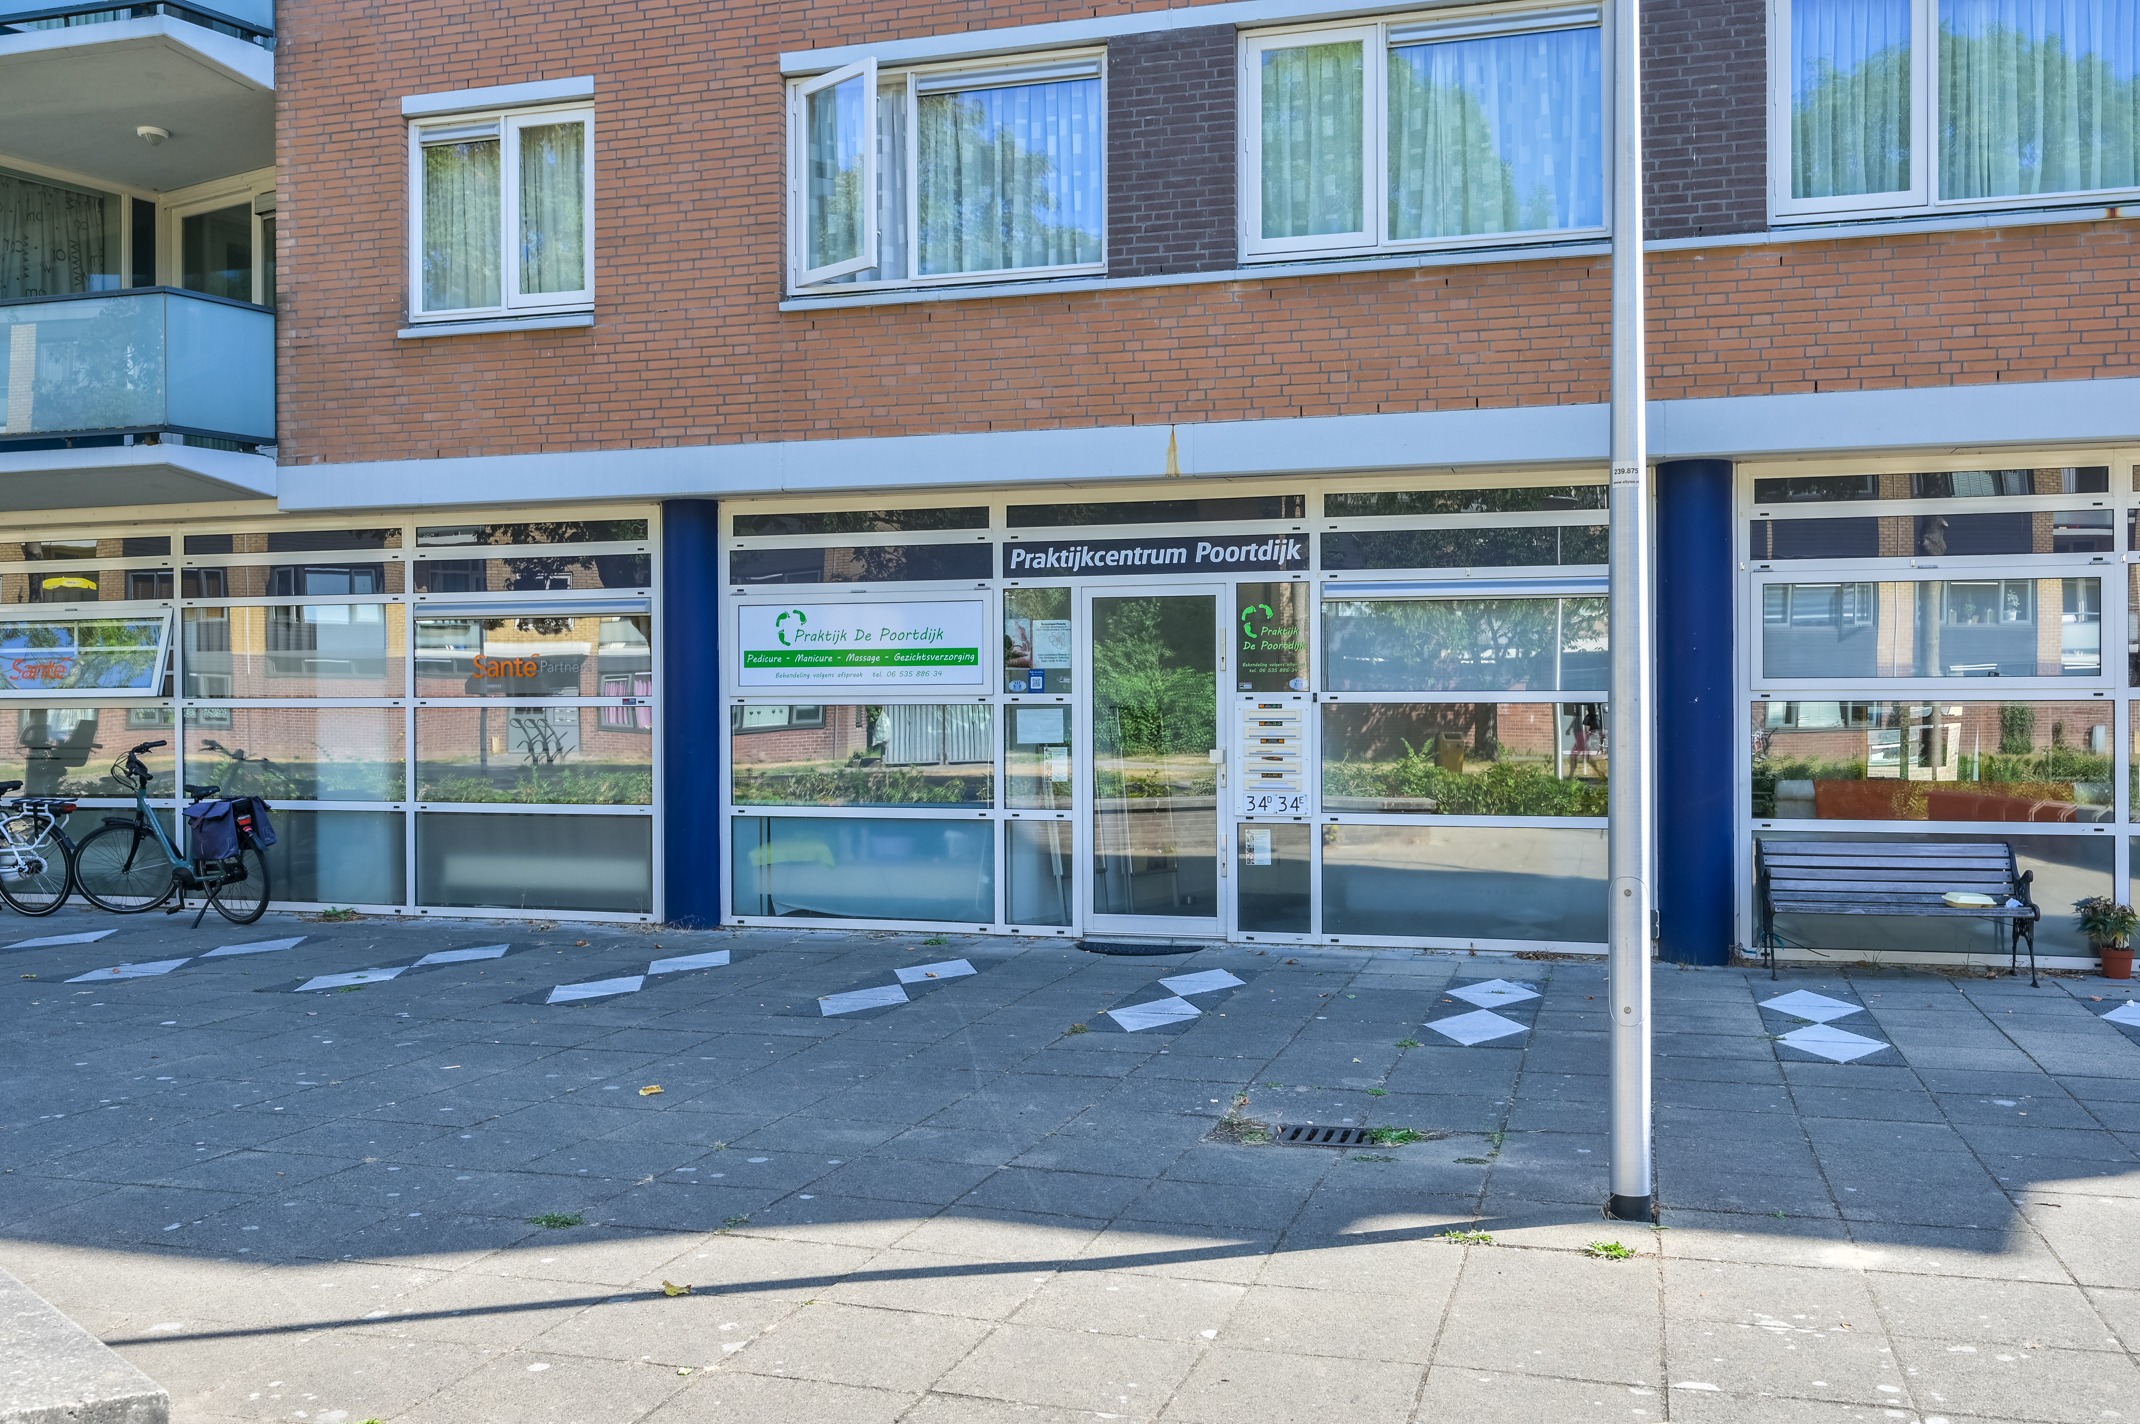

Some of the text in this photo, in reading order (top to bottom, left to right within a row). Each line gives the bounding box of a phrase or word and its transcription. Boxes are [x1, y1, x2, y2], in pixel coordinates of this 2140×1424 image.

[1010, 539, 1302, 572] Praktijkcentrum Poortdijk
[794, 627, 944, 645] Praktijk De Poortdijk
[1260, 626, 1299, 638] Praktijk
[1243, 640, 1306, 652] De Poortdijk
[473, 653, 541, 678] Santé
[747, 654, 782, 663] Pedicure
[794, 654, 833, 662] Manicure
[845, 653, 881, 664] Massage
[893, 652, 975, 663] Gezichtsverzorging
[9, 657, 71, 680] Santé
